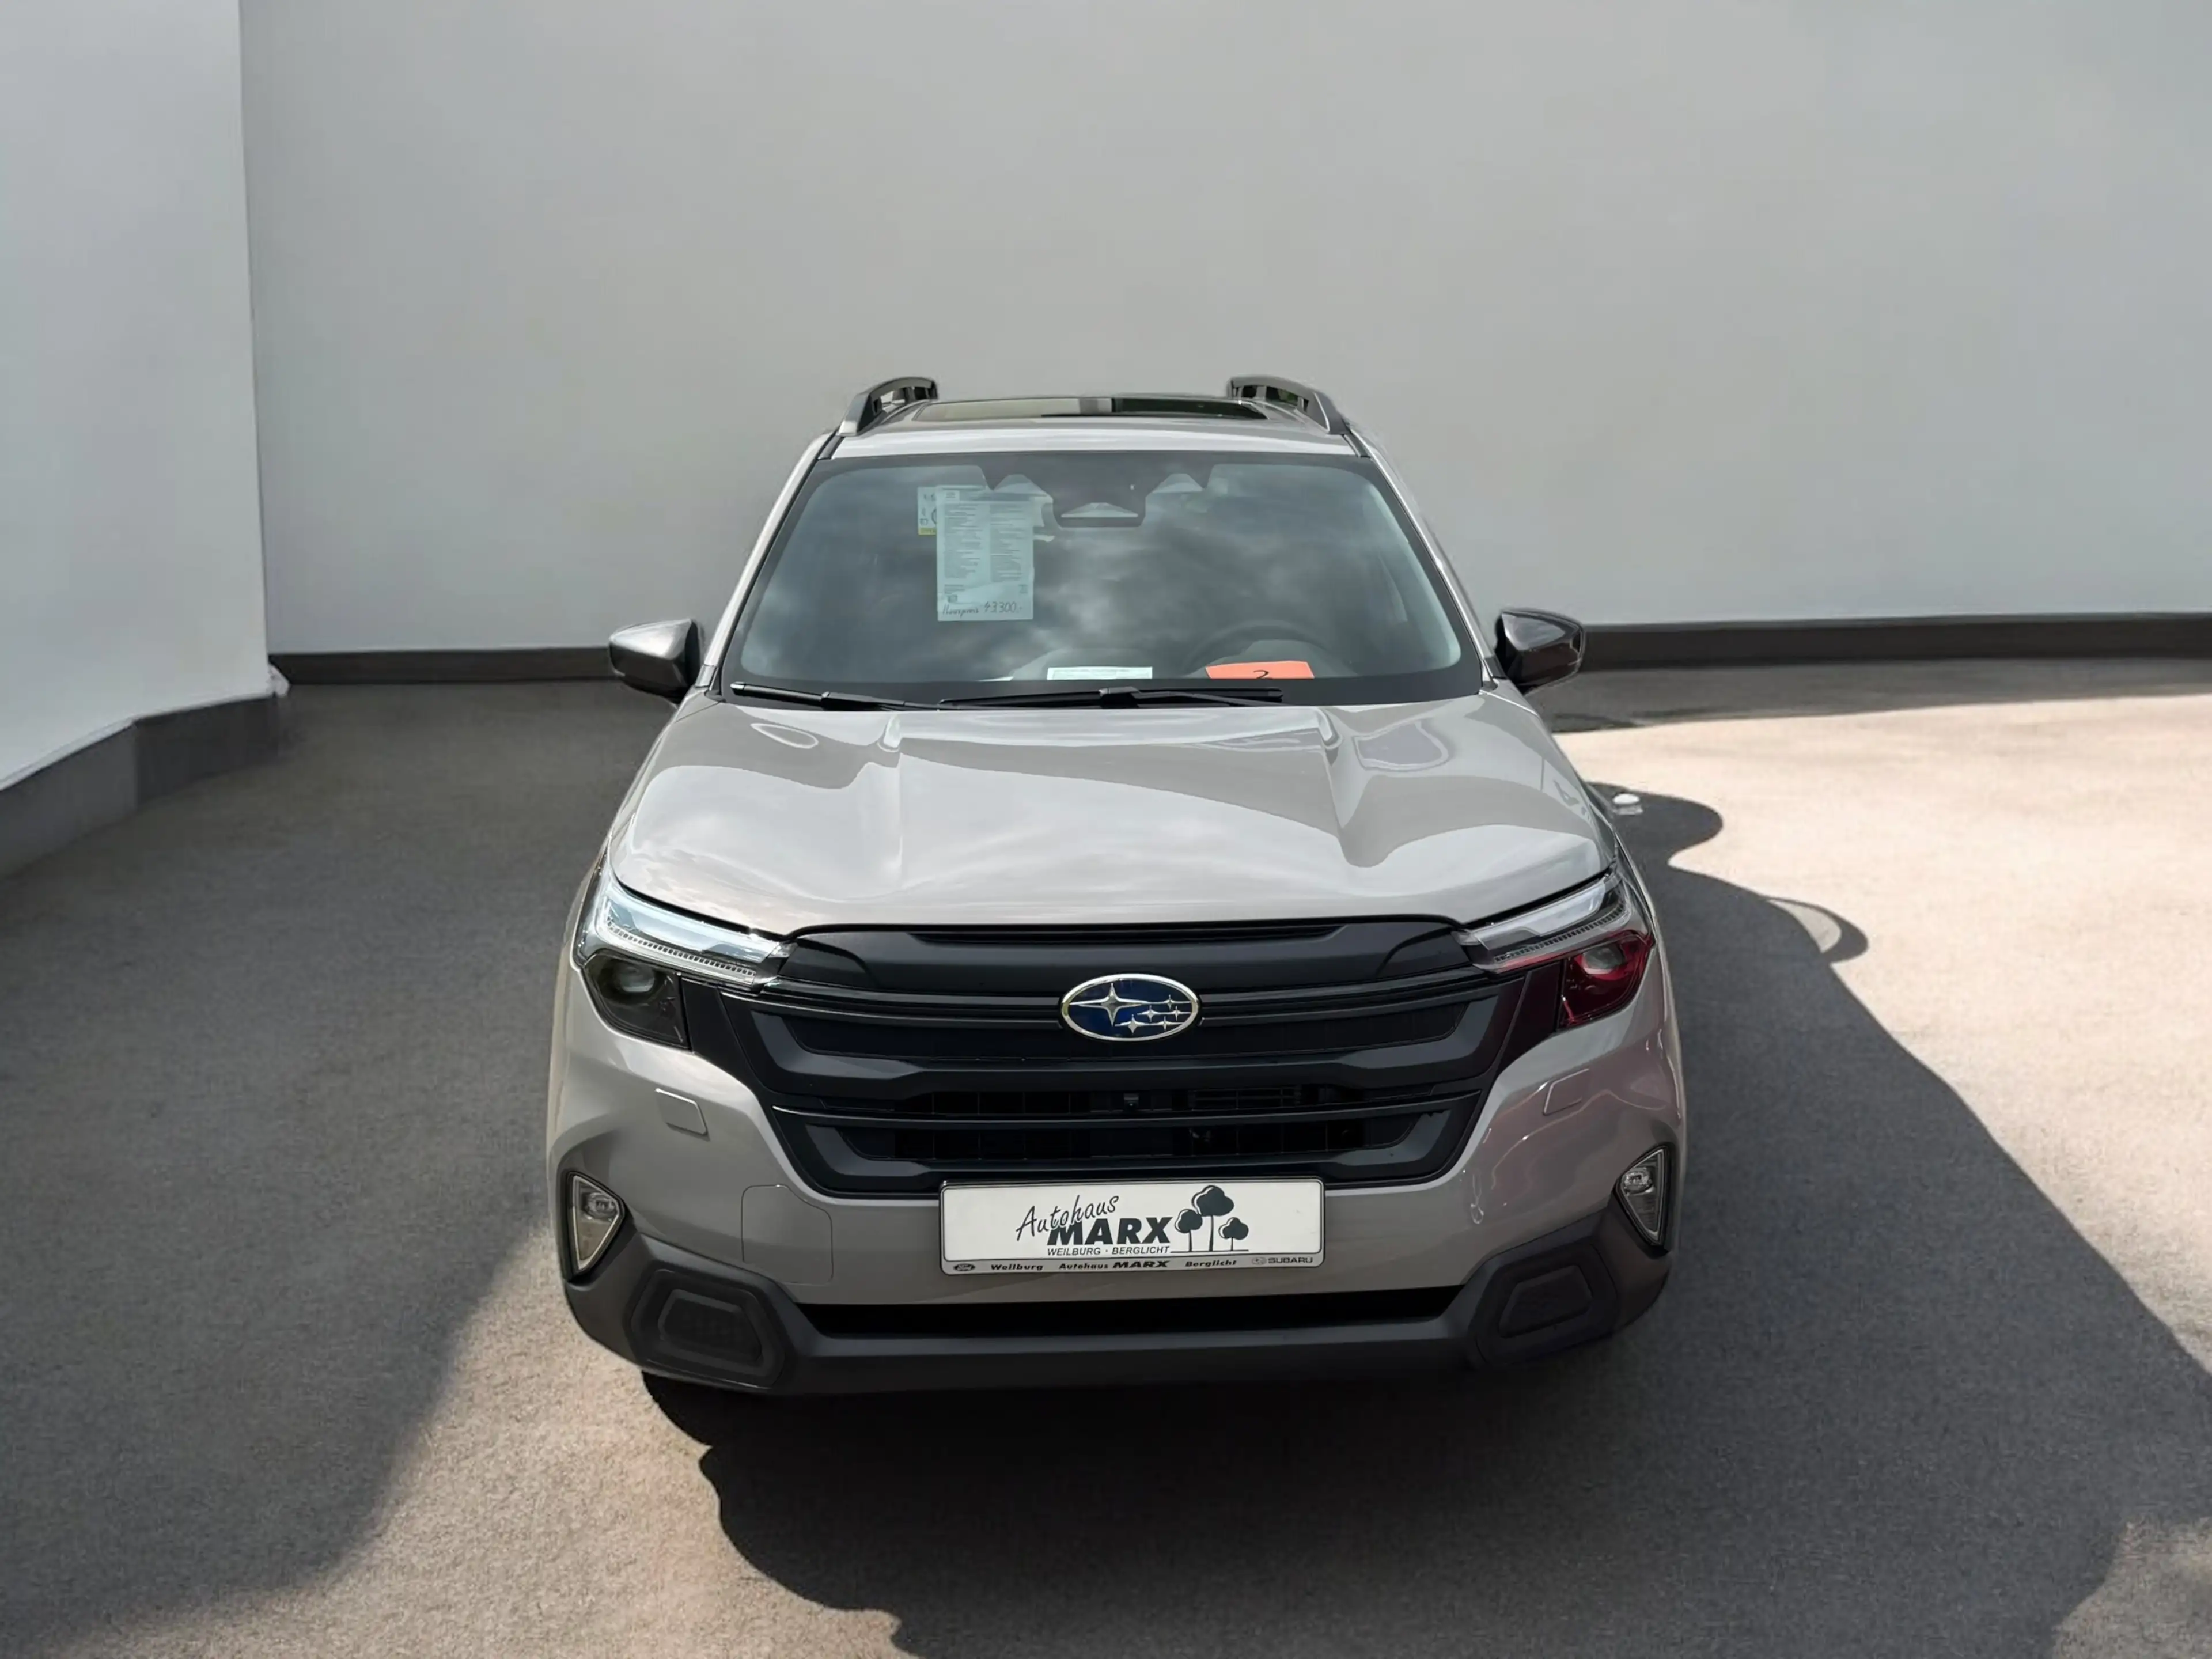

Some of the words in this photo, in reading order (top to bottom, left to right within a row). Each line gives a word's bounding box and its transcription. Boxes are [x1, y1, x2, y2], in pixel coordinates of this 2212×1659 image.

[1016, 1195, 1119, 1241] Autohaus
[1047, 1217, 1173, 1245] MARX
[1047, 1247, 1101, 1256] WEILBURG
[1112, 1246, 1171, 1255] BERGLICHT
[1113, 1260, 1171, 1268] MARX
[1185, 1259, 1237, 1267] Berglicht
[1268, 1256, 1314, 1264] SUBARU
